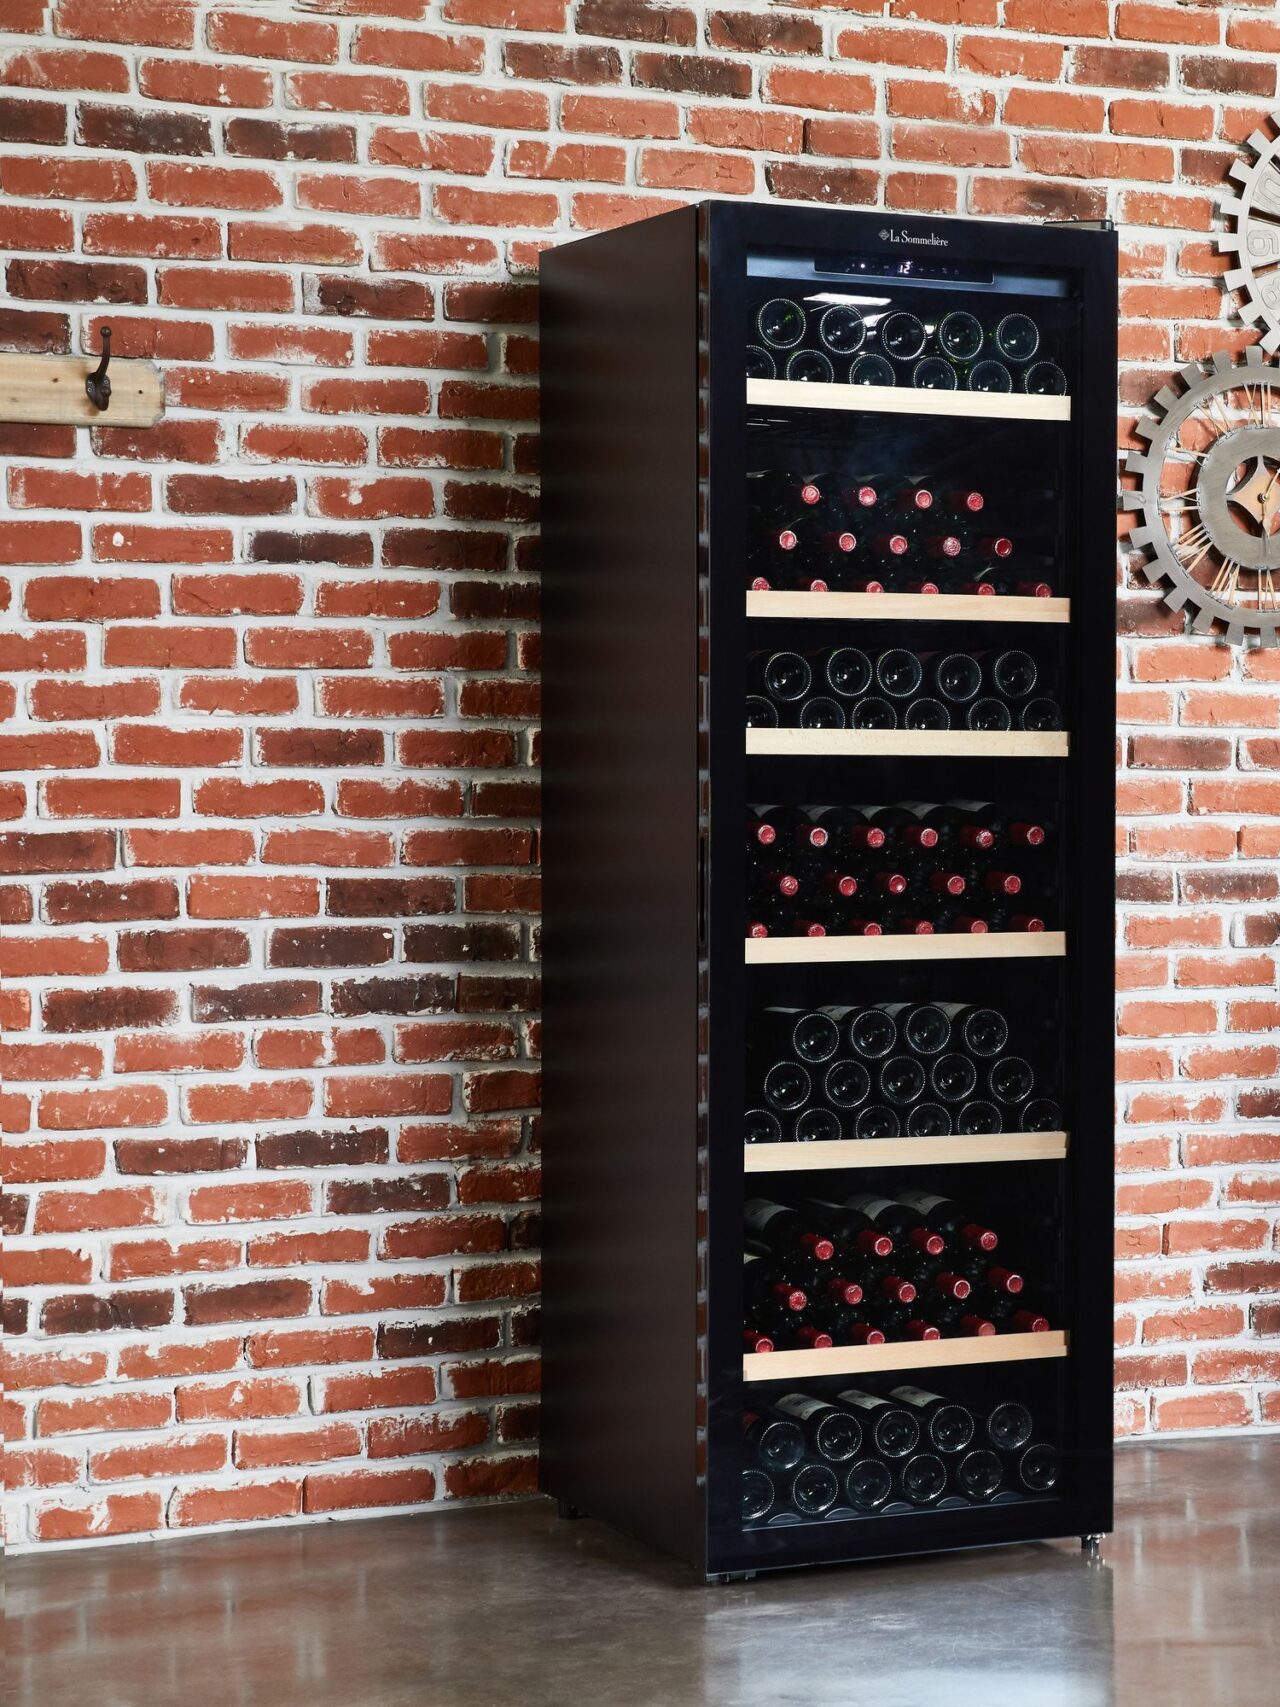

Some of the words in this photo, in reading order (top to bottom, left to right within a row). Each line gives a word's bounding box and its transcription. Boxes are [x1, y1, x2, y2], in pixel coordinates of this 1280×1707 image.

[890, 229, 900, 243] La
[901, 230, 949, 246] Sommelière
[1247, 229, 1280, 257] 9
